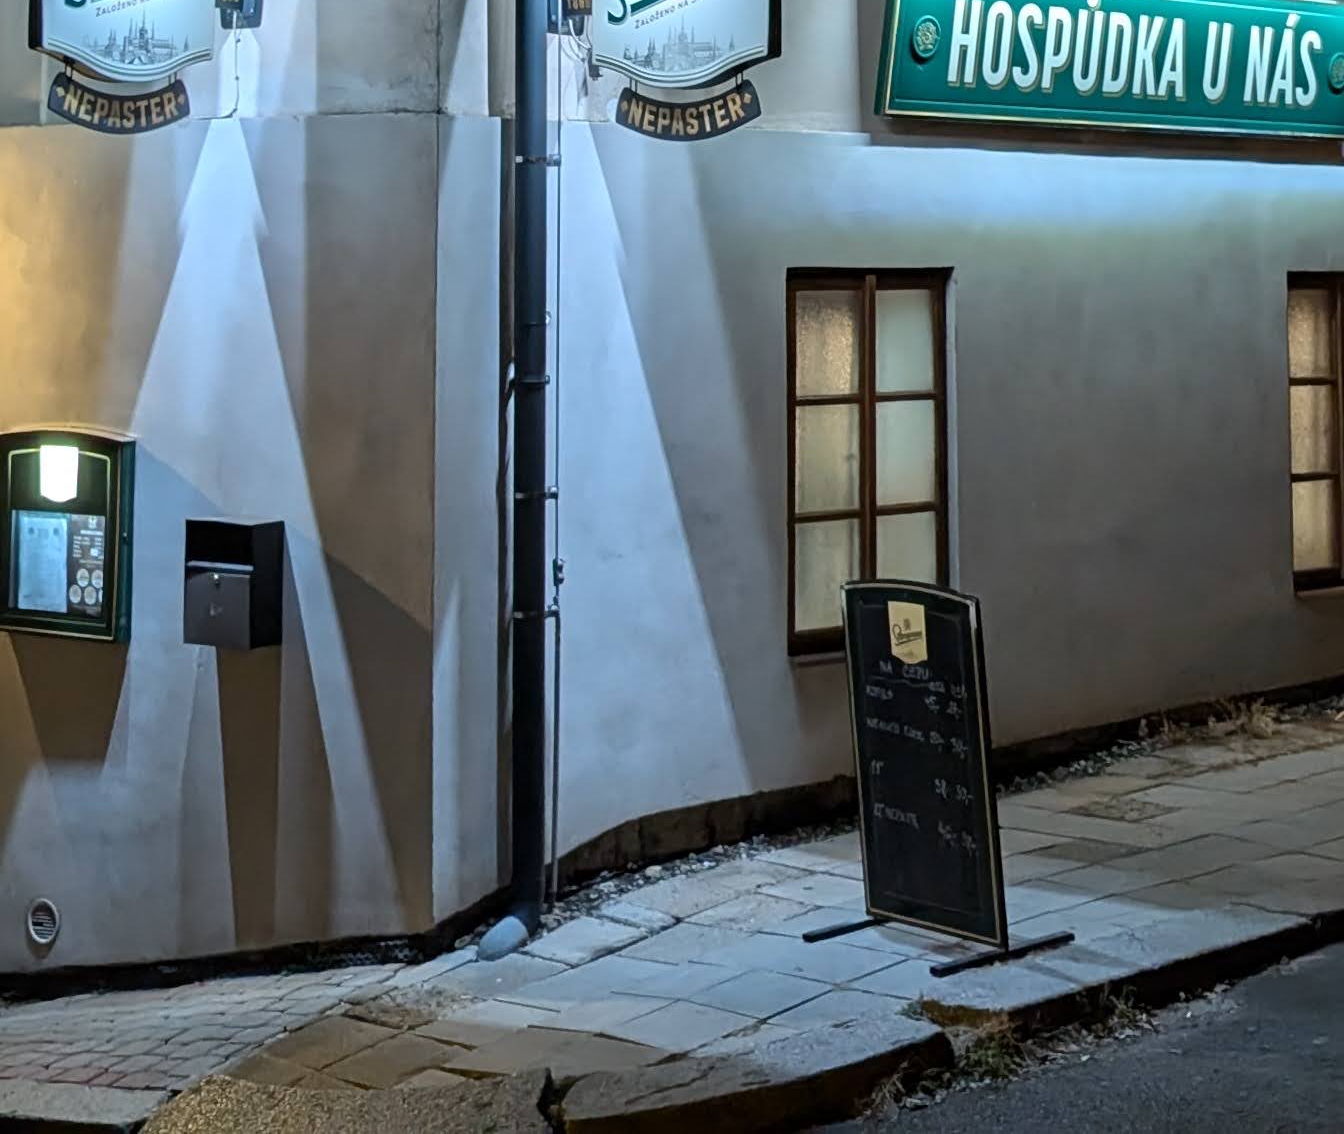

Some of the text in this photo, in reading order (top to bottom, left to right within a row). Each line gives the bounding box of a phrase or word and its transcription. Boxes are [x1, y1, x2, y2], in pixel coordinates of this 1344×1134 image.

[1201, 20, 1235, 103] U
[1242, 13, 1323, 107] NÁS
[62, 86, 179, 129] NEPASTER
[626, 91, 745, 137] NEPASTER
